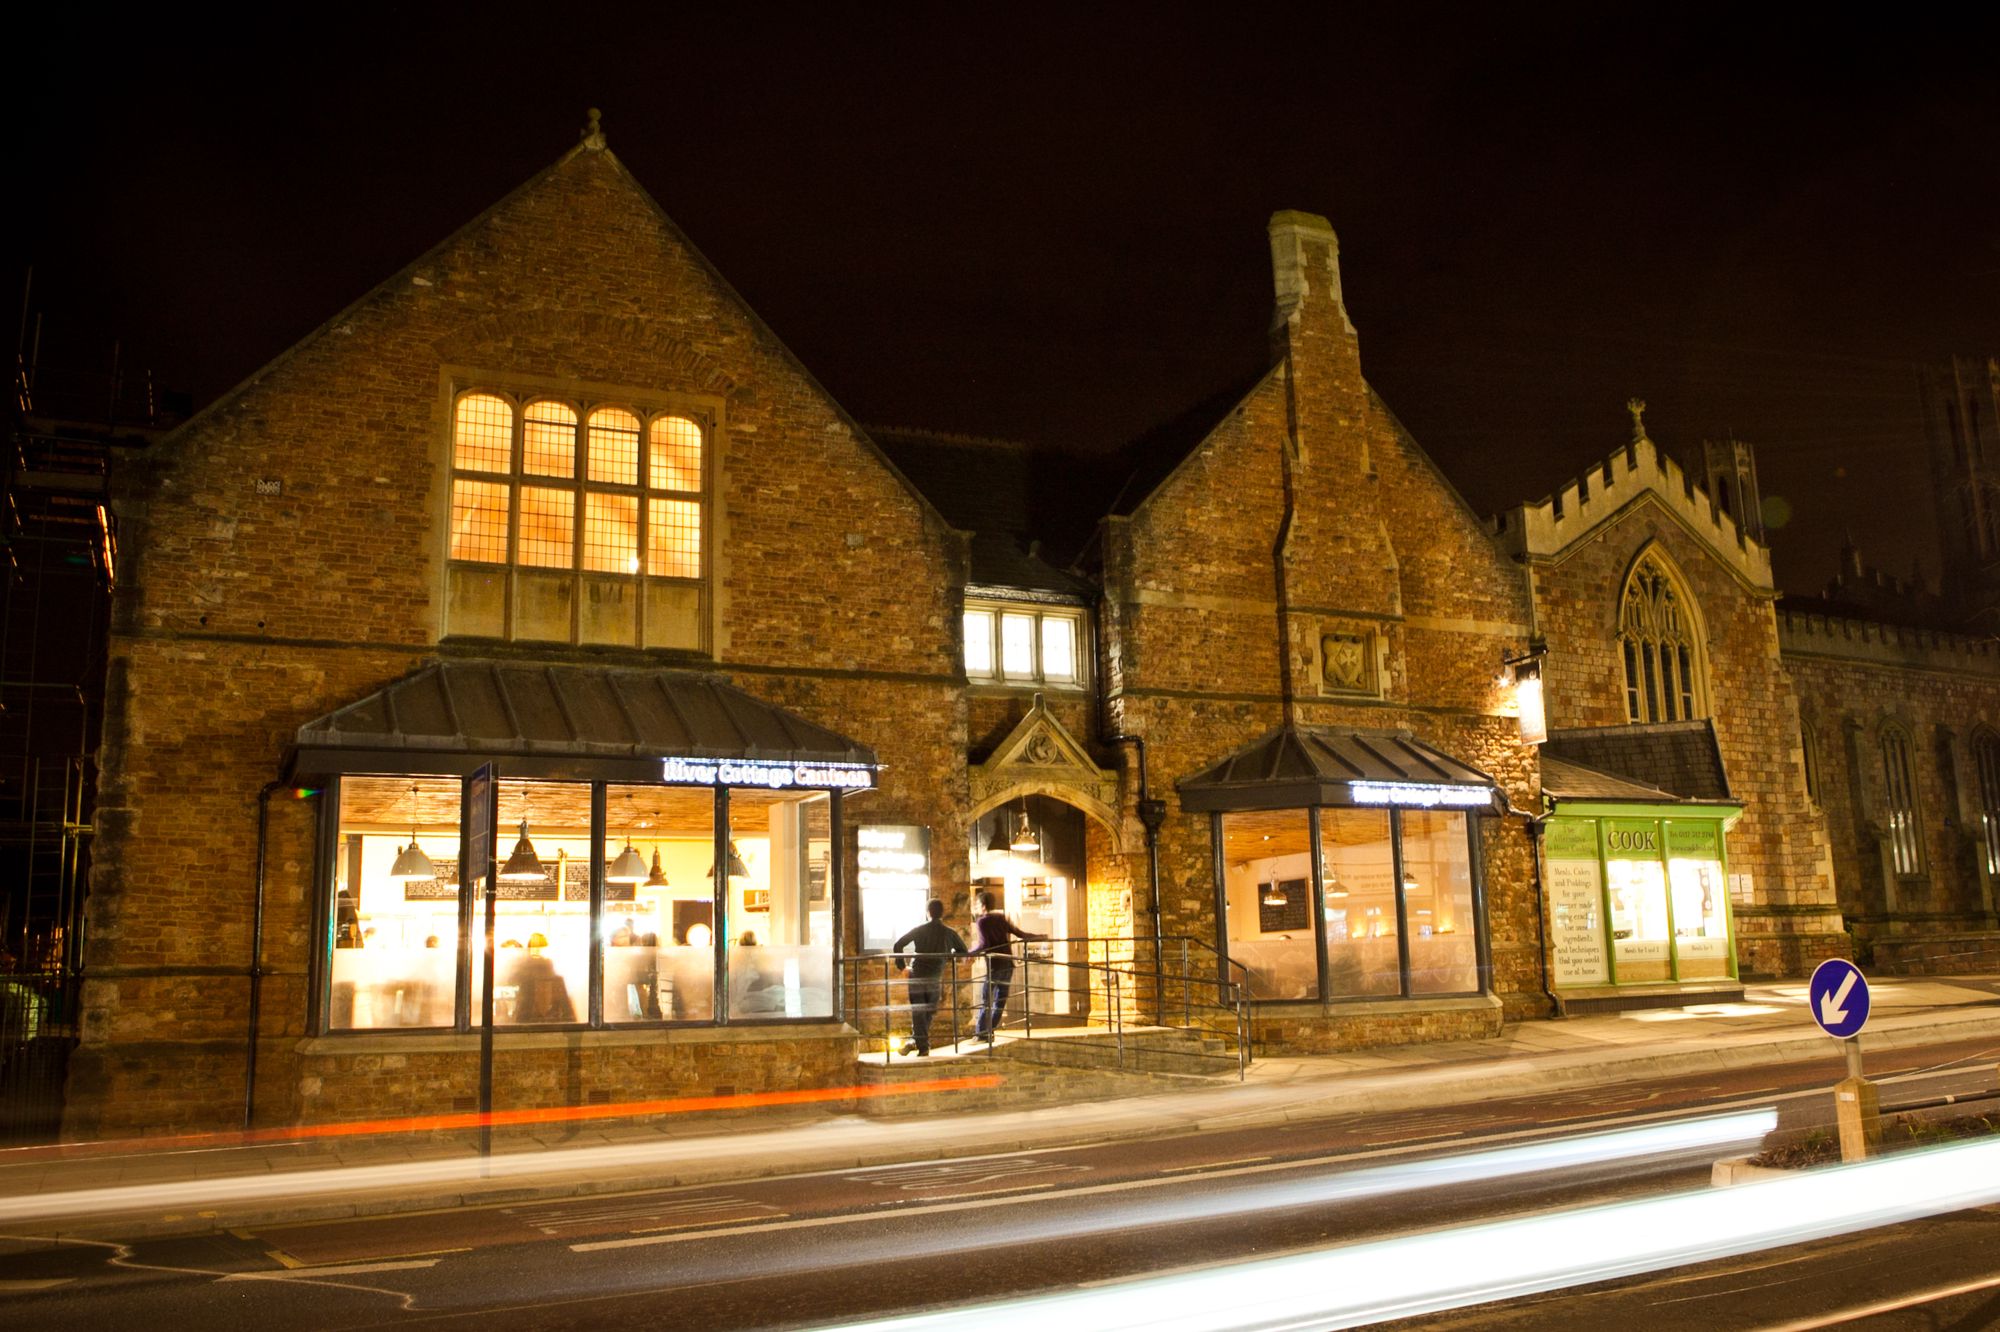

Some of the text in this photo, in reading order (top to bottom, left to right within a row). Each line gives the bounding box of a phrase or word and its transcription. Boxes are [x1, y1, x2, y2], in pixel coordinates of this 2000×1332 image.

[664, 760, 872, 789] River Cottage Canteen
[1608, 831, 1656, 851] COOK
